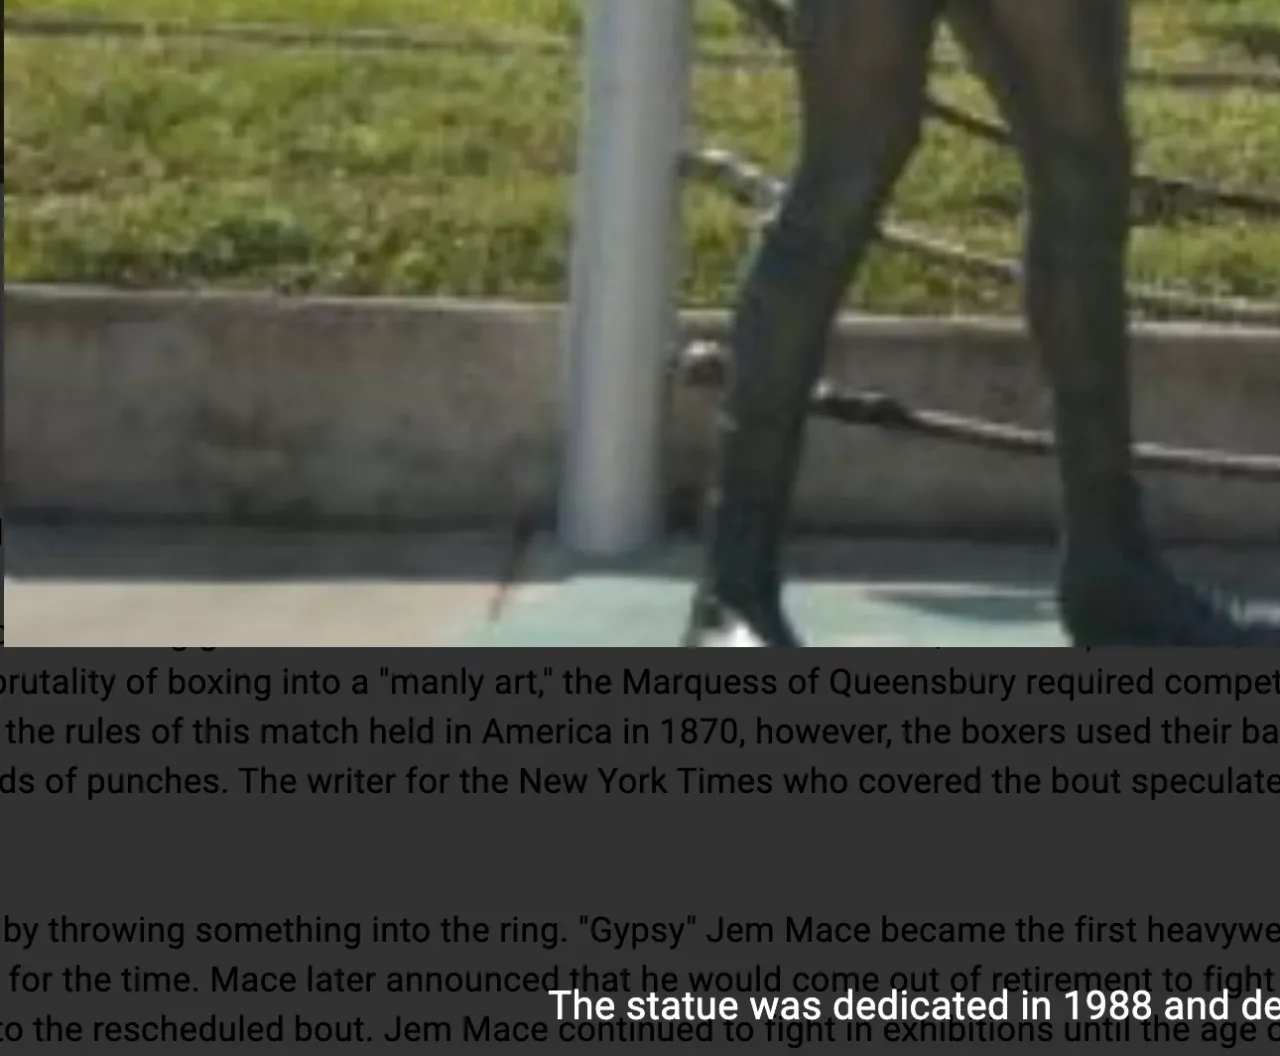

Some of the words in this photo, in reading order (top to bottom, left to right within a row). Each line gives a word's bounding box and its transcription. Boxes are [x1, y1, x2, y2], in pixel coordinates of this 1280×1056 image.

[126, 666, 159, 695] of
[168, 666, 271, 702] boxing
[283, 667, 341, 695] into
[351, 674, 369, 695] a
[379, 666, 485, 702] "manly
[495, 666, 553, 699] art,"
[562, 666, 613, 695] the
[623, 668, 777, 702] Marquess
[788, 666, 821, 695] of
[829, 666, 1016, 702] Queensbury
[1026, 666, 1154, 702] required
[4, 716, 55, 745] the
[65, 716, 141, 745] rules
[151, 715, 184, 745] of
[191, 716, 250, 745] this
[260, 716, 358, 745] match
[370, 716, 434, 745] held
[446, 717, 472, 745] in
[481, 717, 612, 745] America
[623, 717, 649, 745] in
[661, 717, 745, 749] 1870,
[756, 716, 892, 749] however,
[901, 716, 951, 745] the
[962, 716, 1066, 745] boxers
[1077, 716, 1151, 745] used
[1160, 716, 1232, 745] their
[45, 765, 79, 794] of
[87, 765, 228, 801] punches.
[238, 765, 297, 794] The
[306, 766, 397, 794] writer
[405, 765, 451, 794] for
[458, 765, 509, 794] the
[520, 767, 588, 794] New
[597, 765, 669, 794] York
[676, 767, 773, 794] Times
[782, 765, 848, 794] who
[858, 765, 981, 794] covered
[991, 765, 1041, 794] the
[1052, 765, 1122, 794] bout
[4, 914, 39, 950] by
[47, 914, 185, 950] throwing
[195, 914, 361, 950] something
[373, 916, 431, 943] into
[439, 914, 490, 943] the
[500, 915, 567, 950] ring.
[579, 914, 696, 950] "Gypsy"
[706, 916, 774, 943] Jem
[786, 916, 871, 943] Mace
[881, 914, 1006, 943] became
[1014, 914, 1065, 943] the
[1074, 914, 1137, 943] first
[8, 963, 54, 994] for
[61, 964, 112, 994] the
[120, 965, 199, 994] time.
[211, 965, 297, 994] Mace
[307, 964, 377, 994] later
[386, 964, 559, 994] announced
[569, 964, 631, 994] that
[641, 964, 679, 994] he
[688, 964, 781, 994] would
[792, 971, 880, 994] come
[889, 967, 940, 994] out
[950, 963, 983, 994] of
[992, 965, 1153, 994] retirement
[1161, 967, 1193, 994] to
[1202, 964, 1275, 1001] fight
[32, 1014, 83, 1043] the
[93, 1014, 284, 1043] rescheduled
[295, 1014, 373, 1043] bout.
[384, 1014, 452, 1043] Jem
[463, 1014, 548, 1043] Mace
[558, 1015, 713, 1043] continued
[722, 1015, 754, 1043] to
[764, 1015, 836, 1050] fight
[846, 1015, 872, 1043] in
[883, 1015, 1054, 1043] exhibitions
[1064, 1015, 1130, 1043] until
[1139, 1015, 1190, 1043] the
[1200, 1020, 1257, 1050] age
